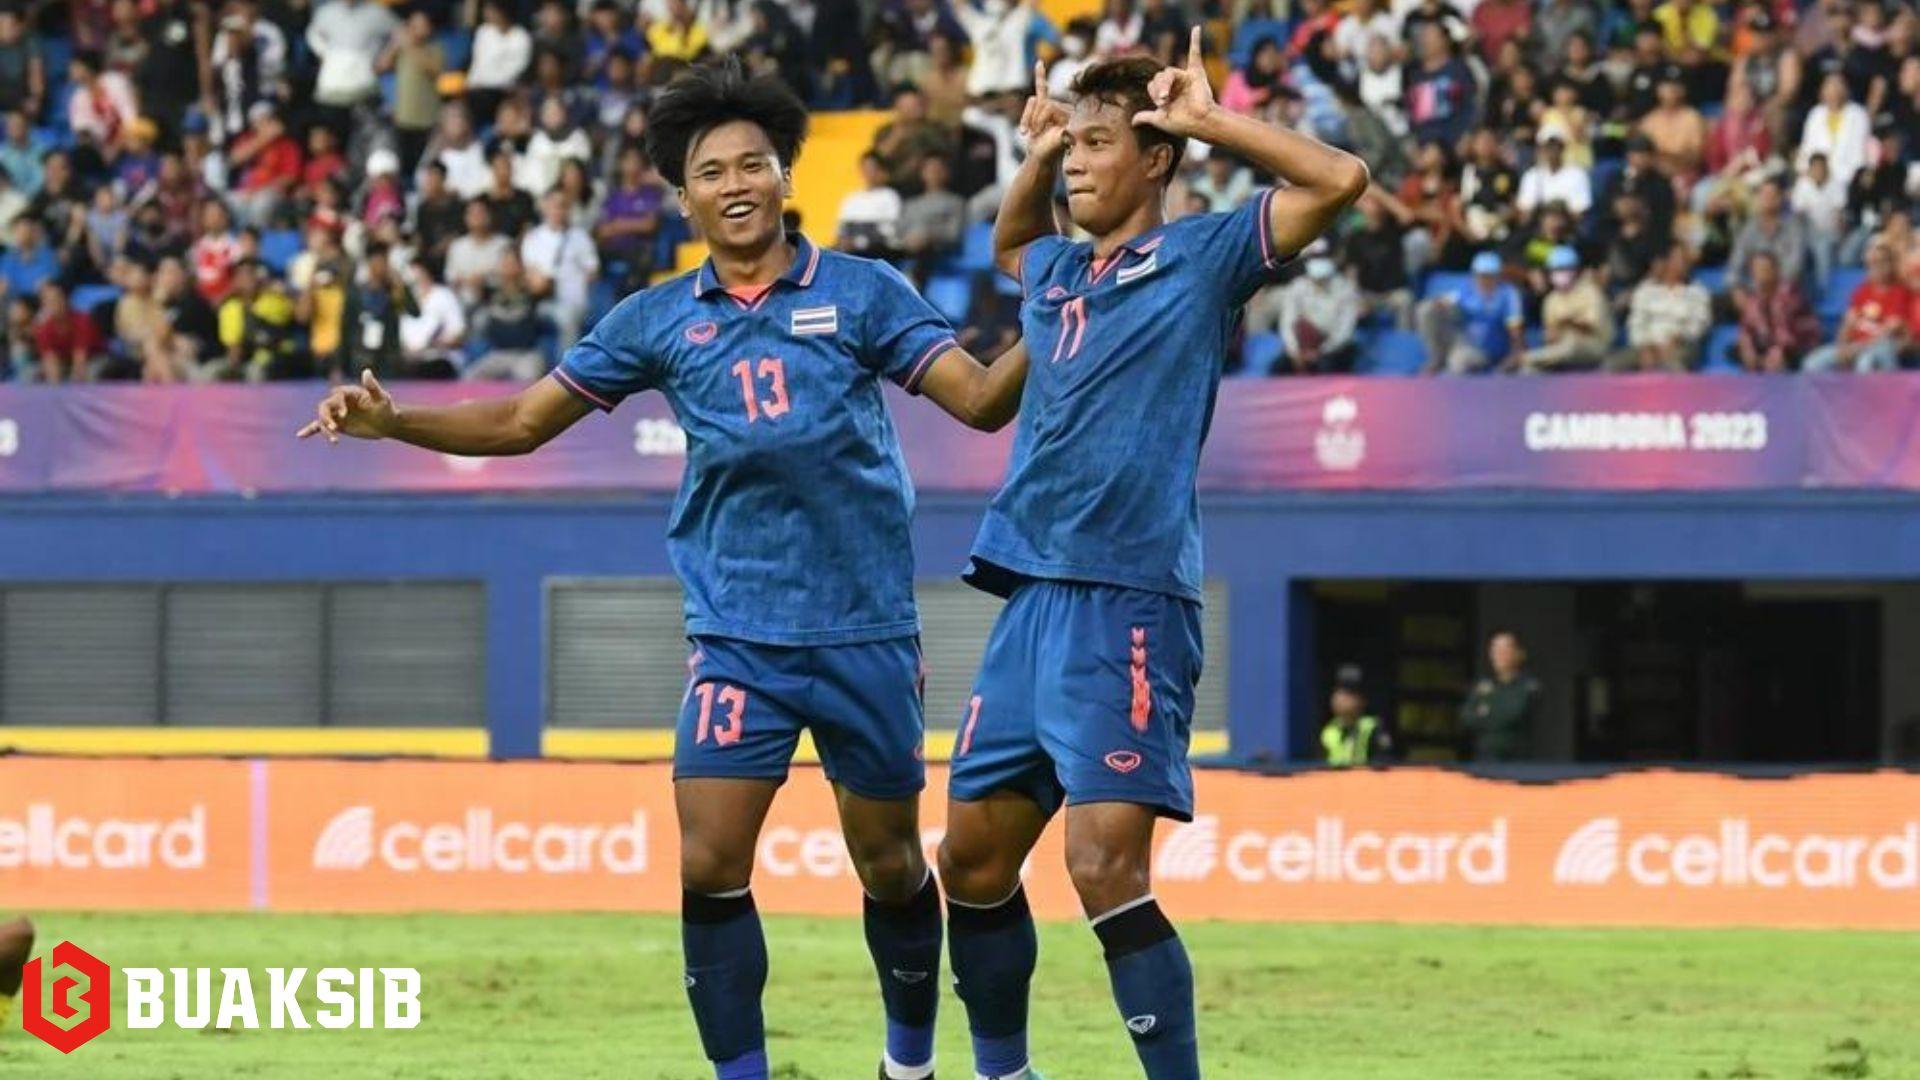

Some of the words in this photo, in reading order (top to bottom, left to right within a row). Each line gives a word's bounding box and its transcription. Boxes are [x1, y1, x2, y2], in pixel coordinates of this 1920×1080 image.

[1051, 296, 1086, 364] 11
[732, 358, 790, 423] 13
[1525, 412, 1687, 450] CAMBODIA
[1690, 412, 1767, 450] 2023
[694, 683, 746, 746] 13
[0, 804, 205, 868] ellcard
[382, 808, 647, 873] cellcard
[1227, 816, 1507, 884] cellcard
[1627, 818, 1920, 888] cellcard
